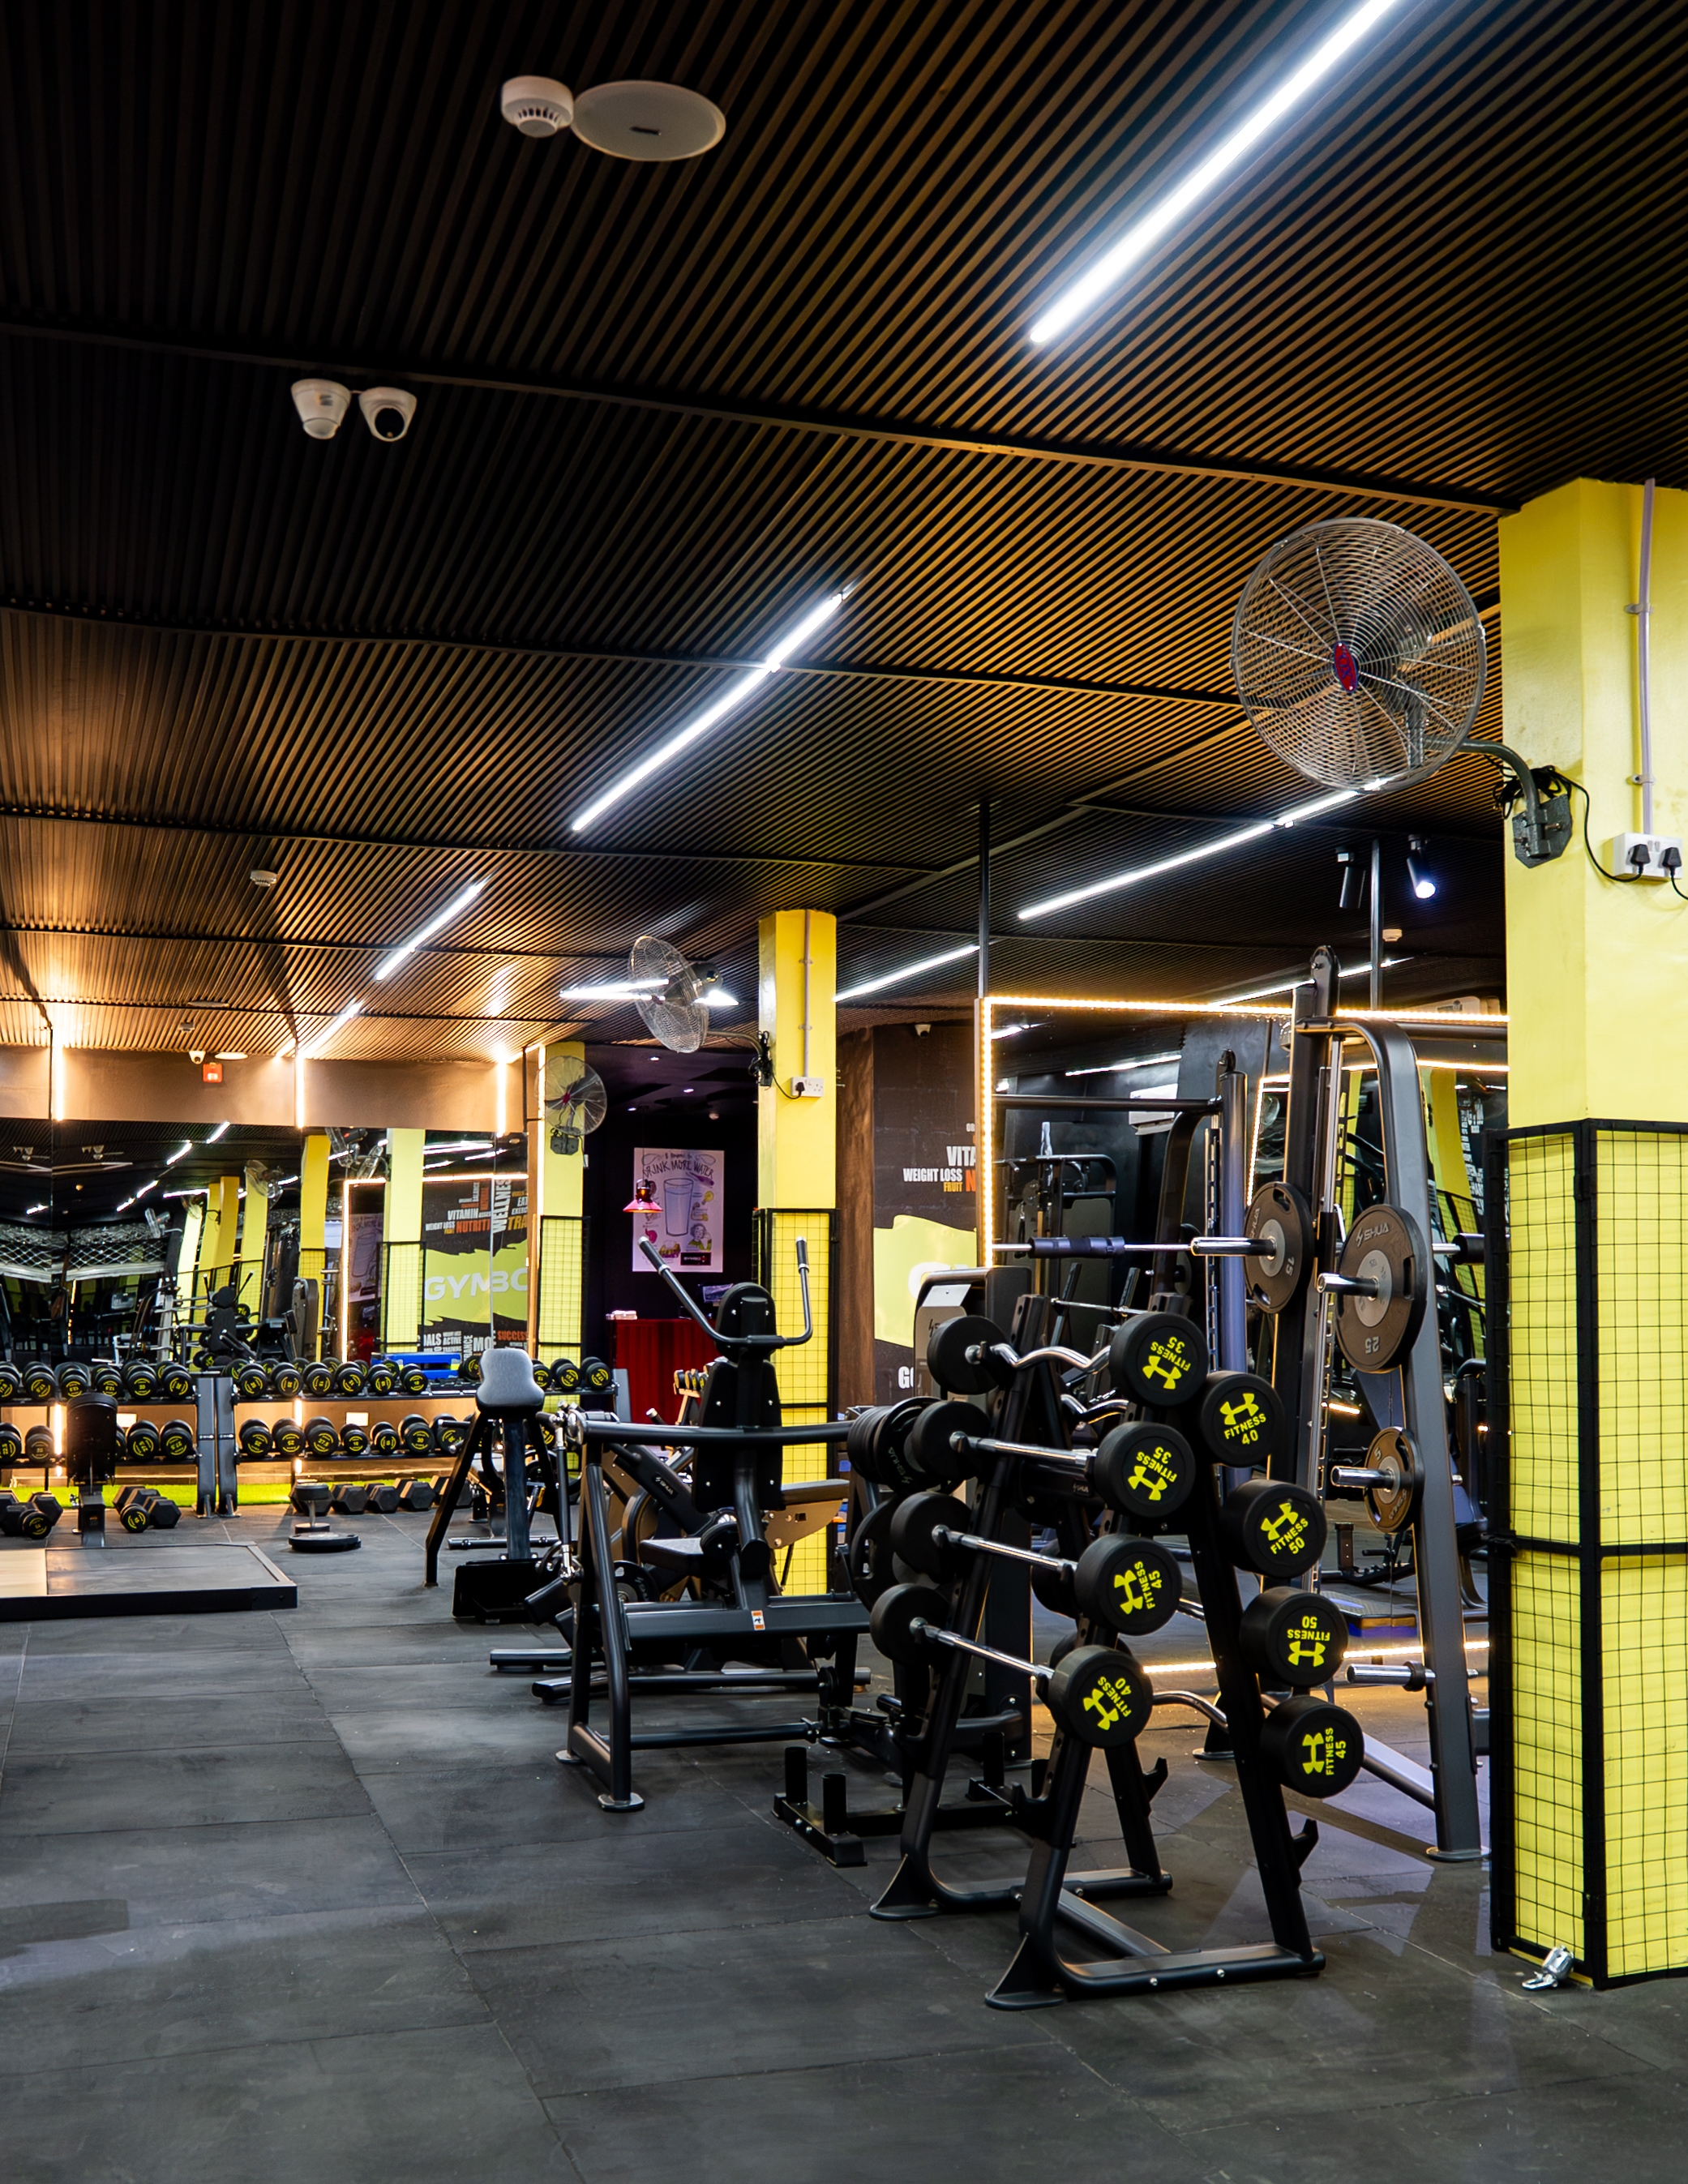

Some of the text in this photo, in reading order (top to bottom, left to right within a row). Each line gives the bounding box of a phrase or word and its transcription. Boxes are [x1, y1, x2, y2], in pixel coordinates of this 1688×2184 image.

[671, 1160, 692, 1171] MORE
[694, 1162, 714, 1180] WATER
[902, 1167, 962, 1182] WEIGHT LOSS
[943, 1182, 963, 1193] FRUIT
[447, 1208, 478, 1221] VITAMIN
[425, 1222, 443, 1231] WEIGHT
[1363, 1222, 1390, 1241] SHUA
[443, 1336, 461, 1346] ACTIVE
[1167, 1336, 1185, 1354] 35
[1364, 1335, 1380, 1355] 25
[1150, 1341, 1192, 1372] FITNESS
[1224, 1413, 1266, 1439] FITNESS
[1241, 1429, 1259, 1445] 40
[1153, 1446, 1172, 1464] 35
[1136, 1451, 1177, 1483] FITNESS
[1270, 1518, 1309, 1554] FITNESS
[1288, 1536, 1305, 1554] 50
[1134, 1561, 1156, 1609] FITNESS
[1148, 1570, 1163, 1589] 45
[1301, 1616, 1317, 1629] 50
[1287, 1629, 1330, 1642] FITNESS
[1115, 1677, 1132, 1696] 40
[1097, 1676, 1132, 1717] FITNESS
[1325, 1727, 1335, 1775] FITNESS
[1335, 1741, 1347, 1759] 45
